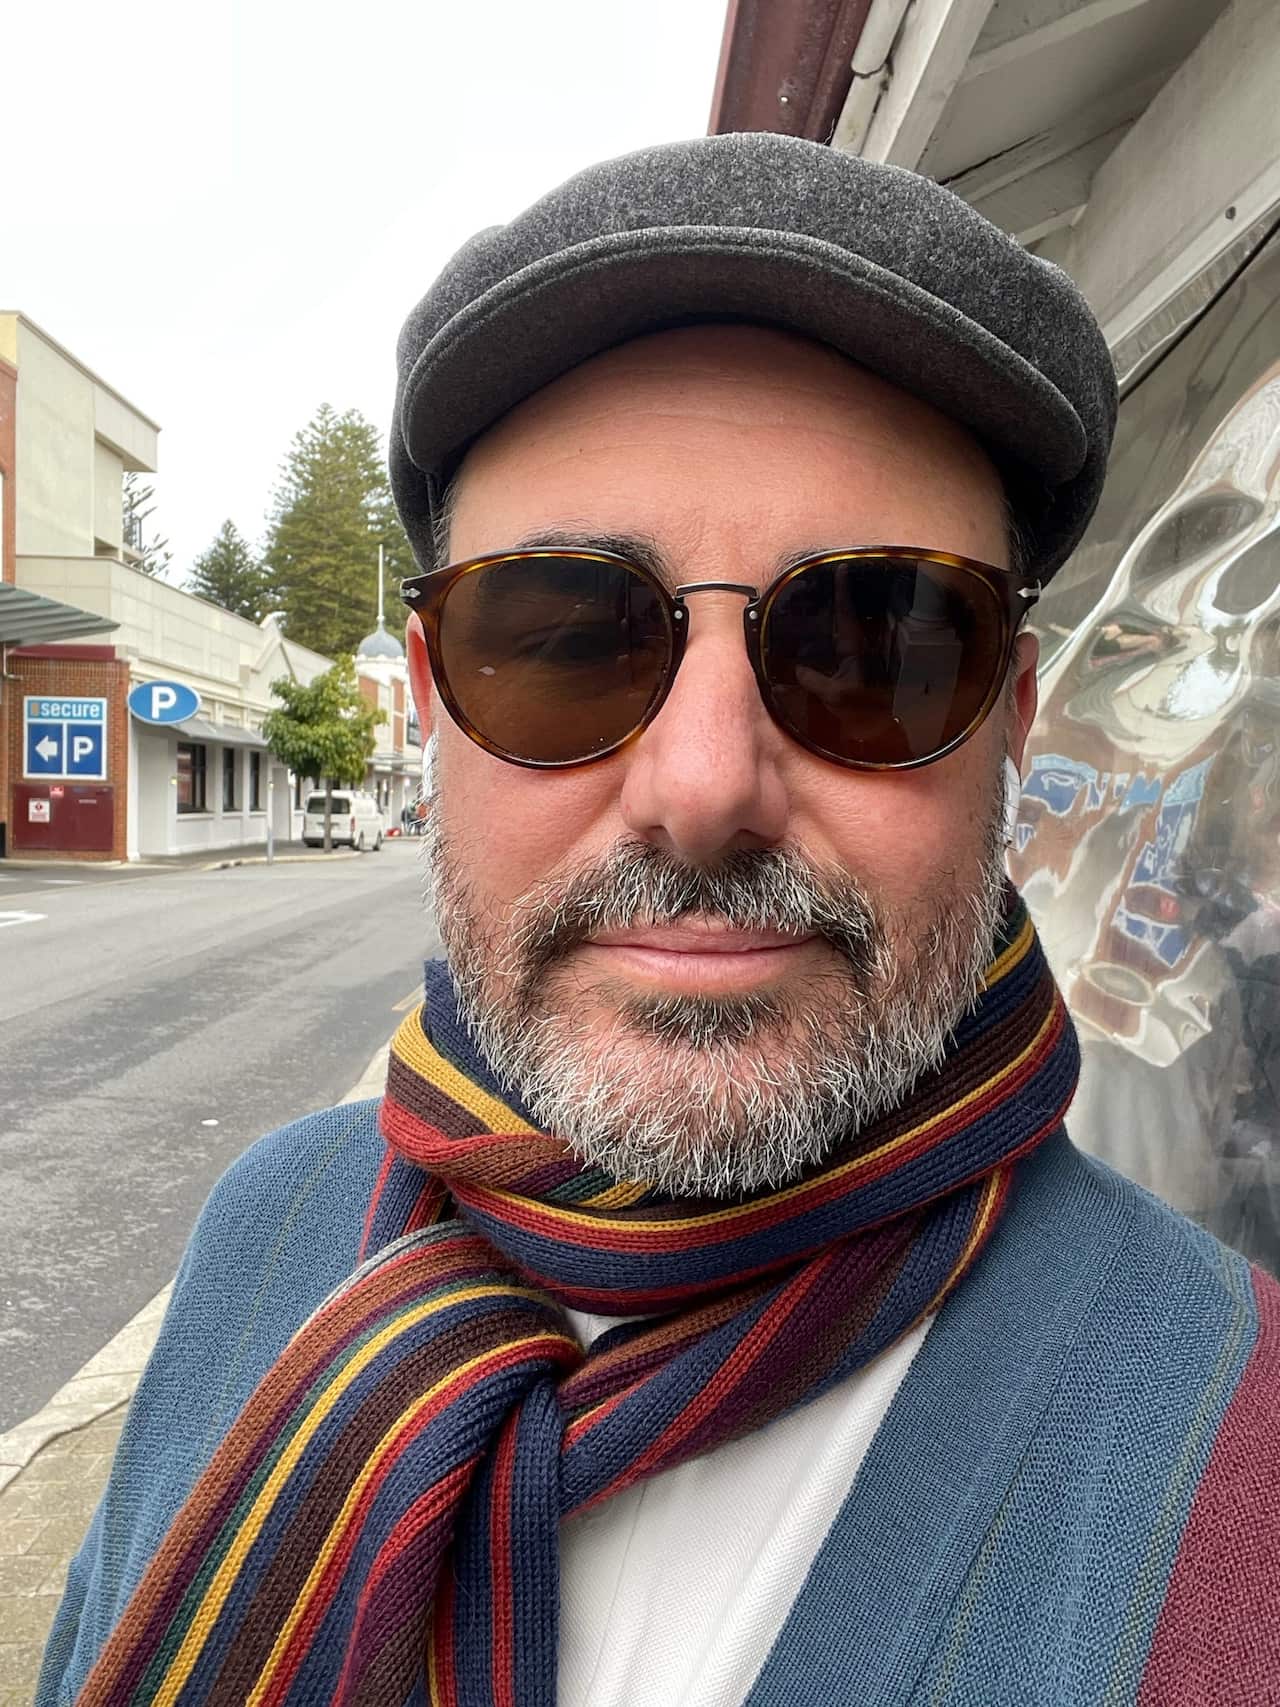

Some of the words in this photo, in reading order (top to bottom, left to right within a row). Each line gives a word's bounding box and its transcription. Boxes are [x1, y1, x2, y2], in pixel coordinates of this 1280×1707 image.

[41, 703, 100, 718] secure
[151, 685, 177, 719] P
[73, 735, 94, 763] P
